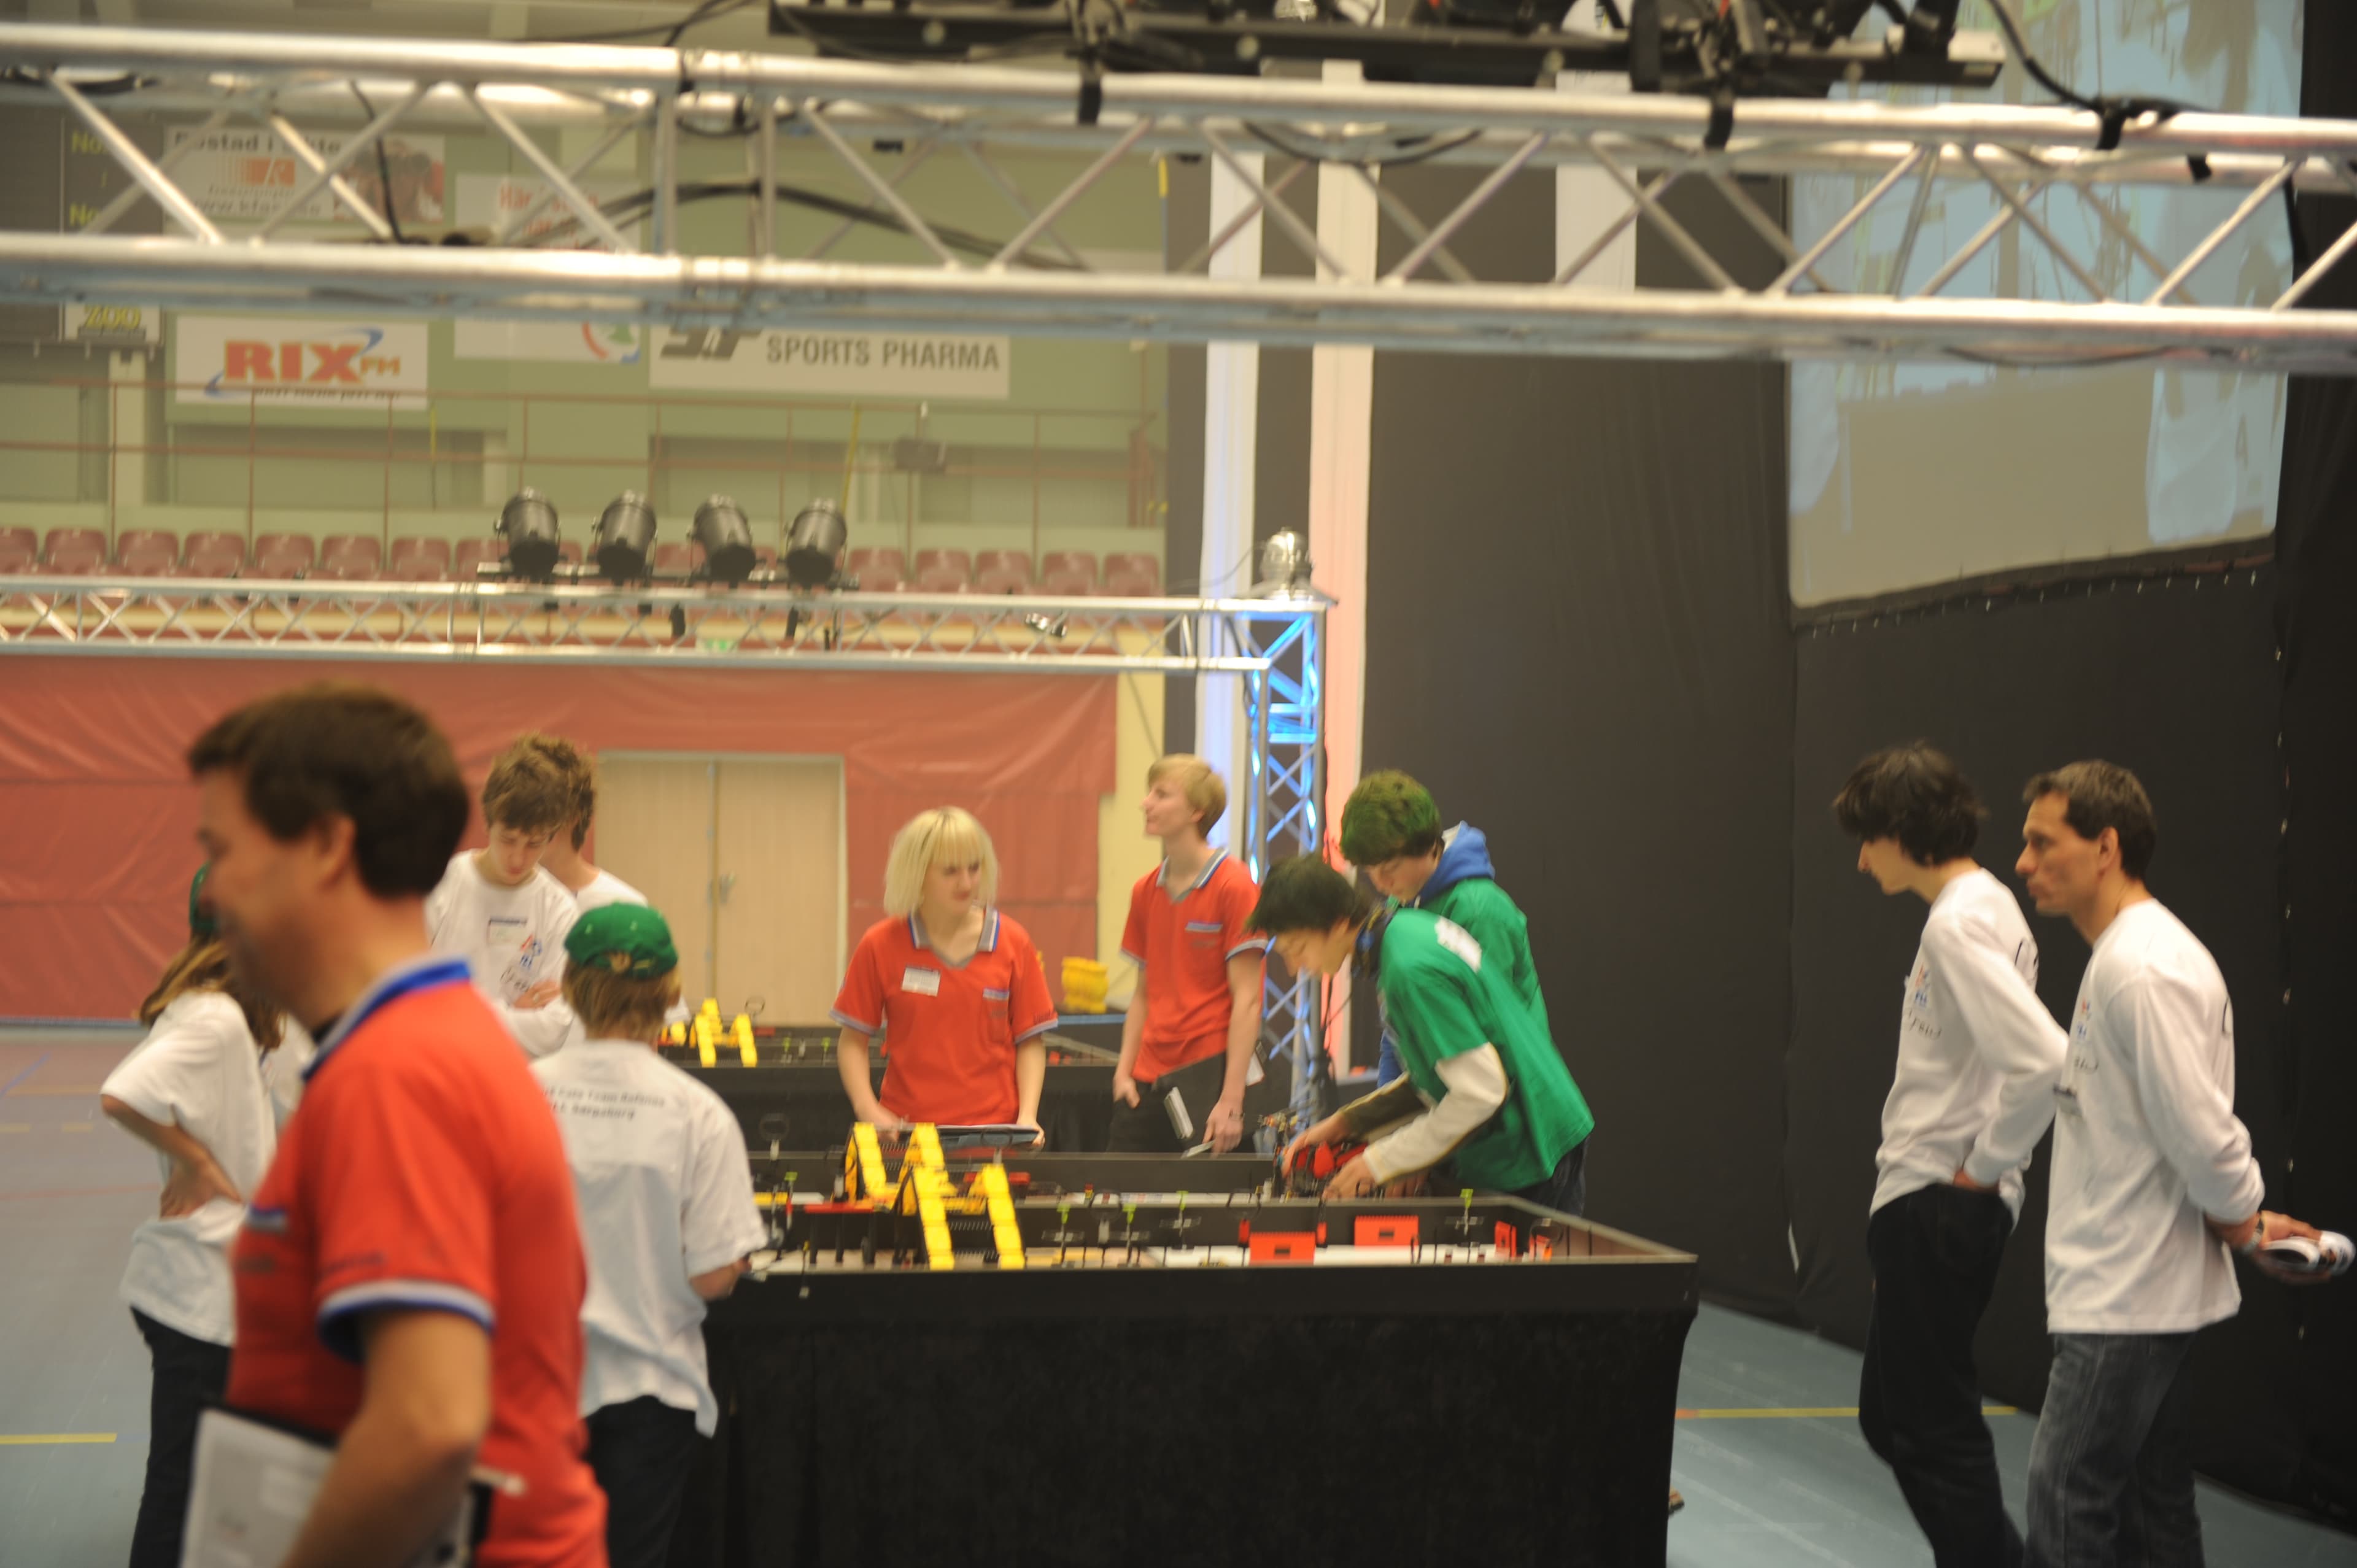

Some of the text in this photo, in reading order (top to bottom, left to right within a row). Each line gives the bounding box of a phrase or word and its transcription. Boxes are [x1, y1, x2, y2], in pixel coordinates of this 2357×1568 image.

[223, 341, 401, 383] RIX FM
[767, 335, 870, 367] SPORTS
[881, 340, 1000, 371] PHARMA
